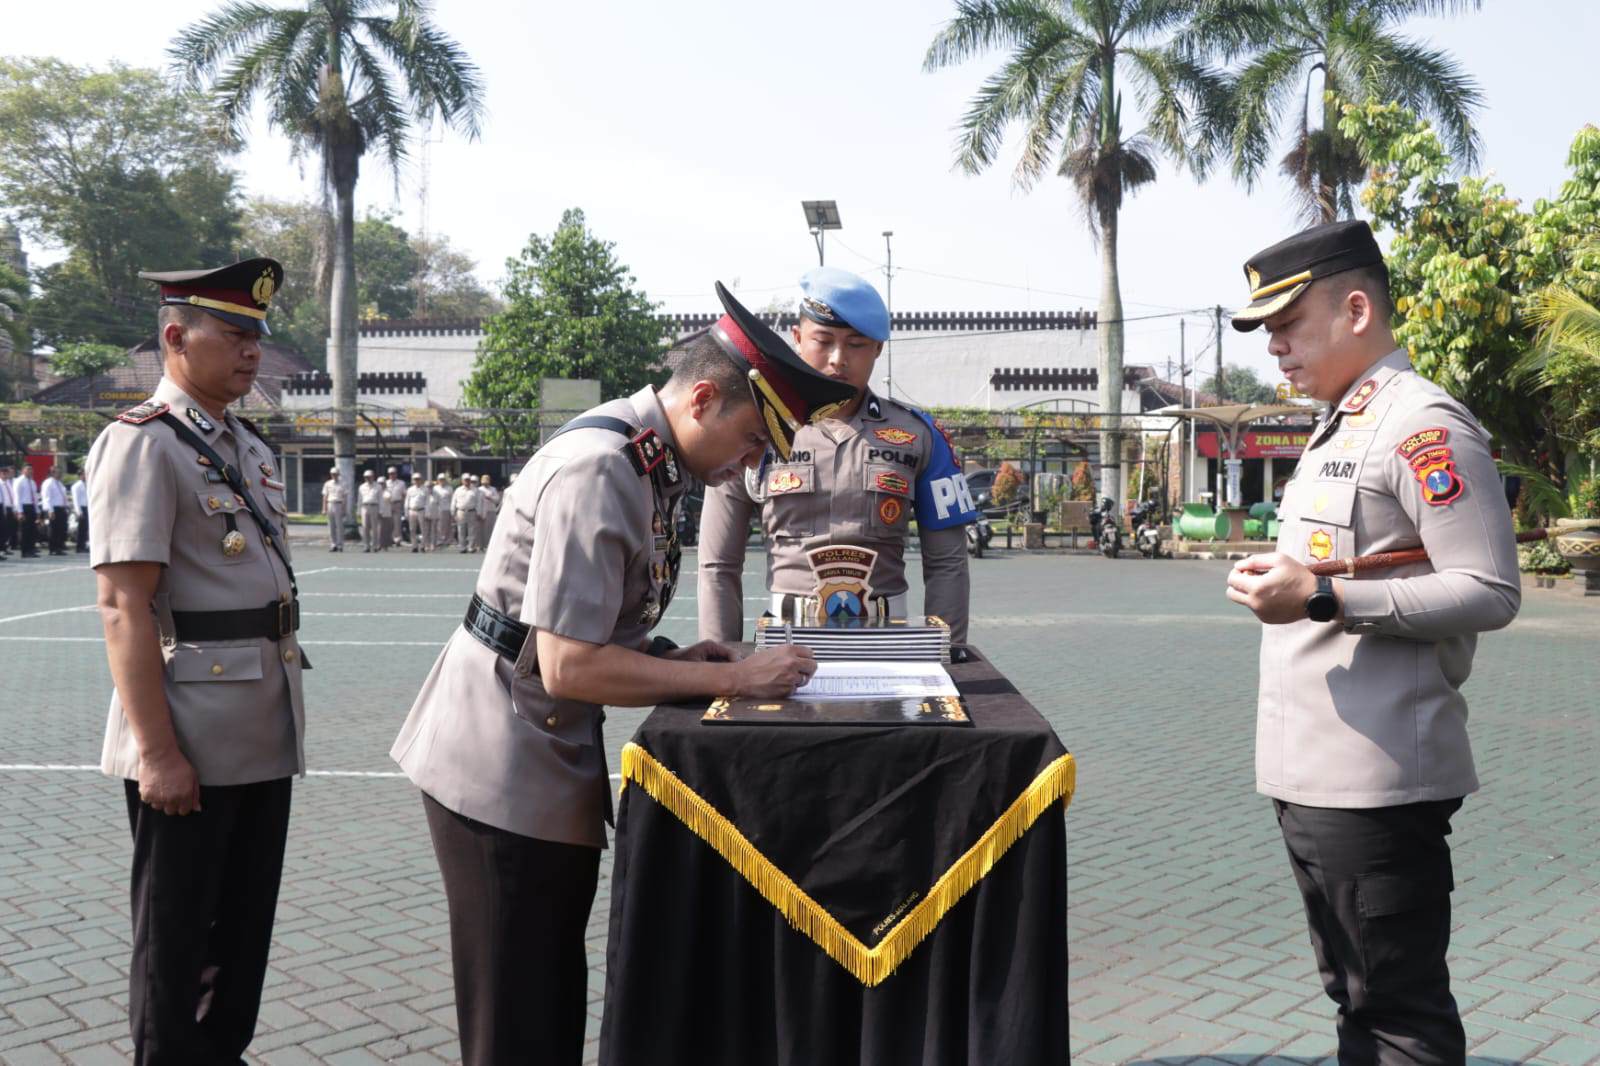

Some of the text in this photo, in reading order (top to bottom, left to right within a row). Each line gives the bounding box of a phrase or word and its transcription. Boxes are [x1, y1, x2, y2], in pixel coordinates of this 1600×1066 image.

[1255, 434, 1290, 446] ZONA
[868, 449, 919, 468] POLRI
[1319, 461, 1357, 479] POLRI
[816, 550, 867, 560] POLRES
